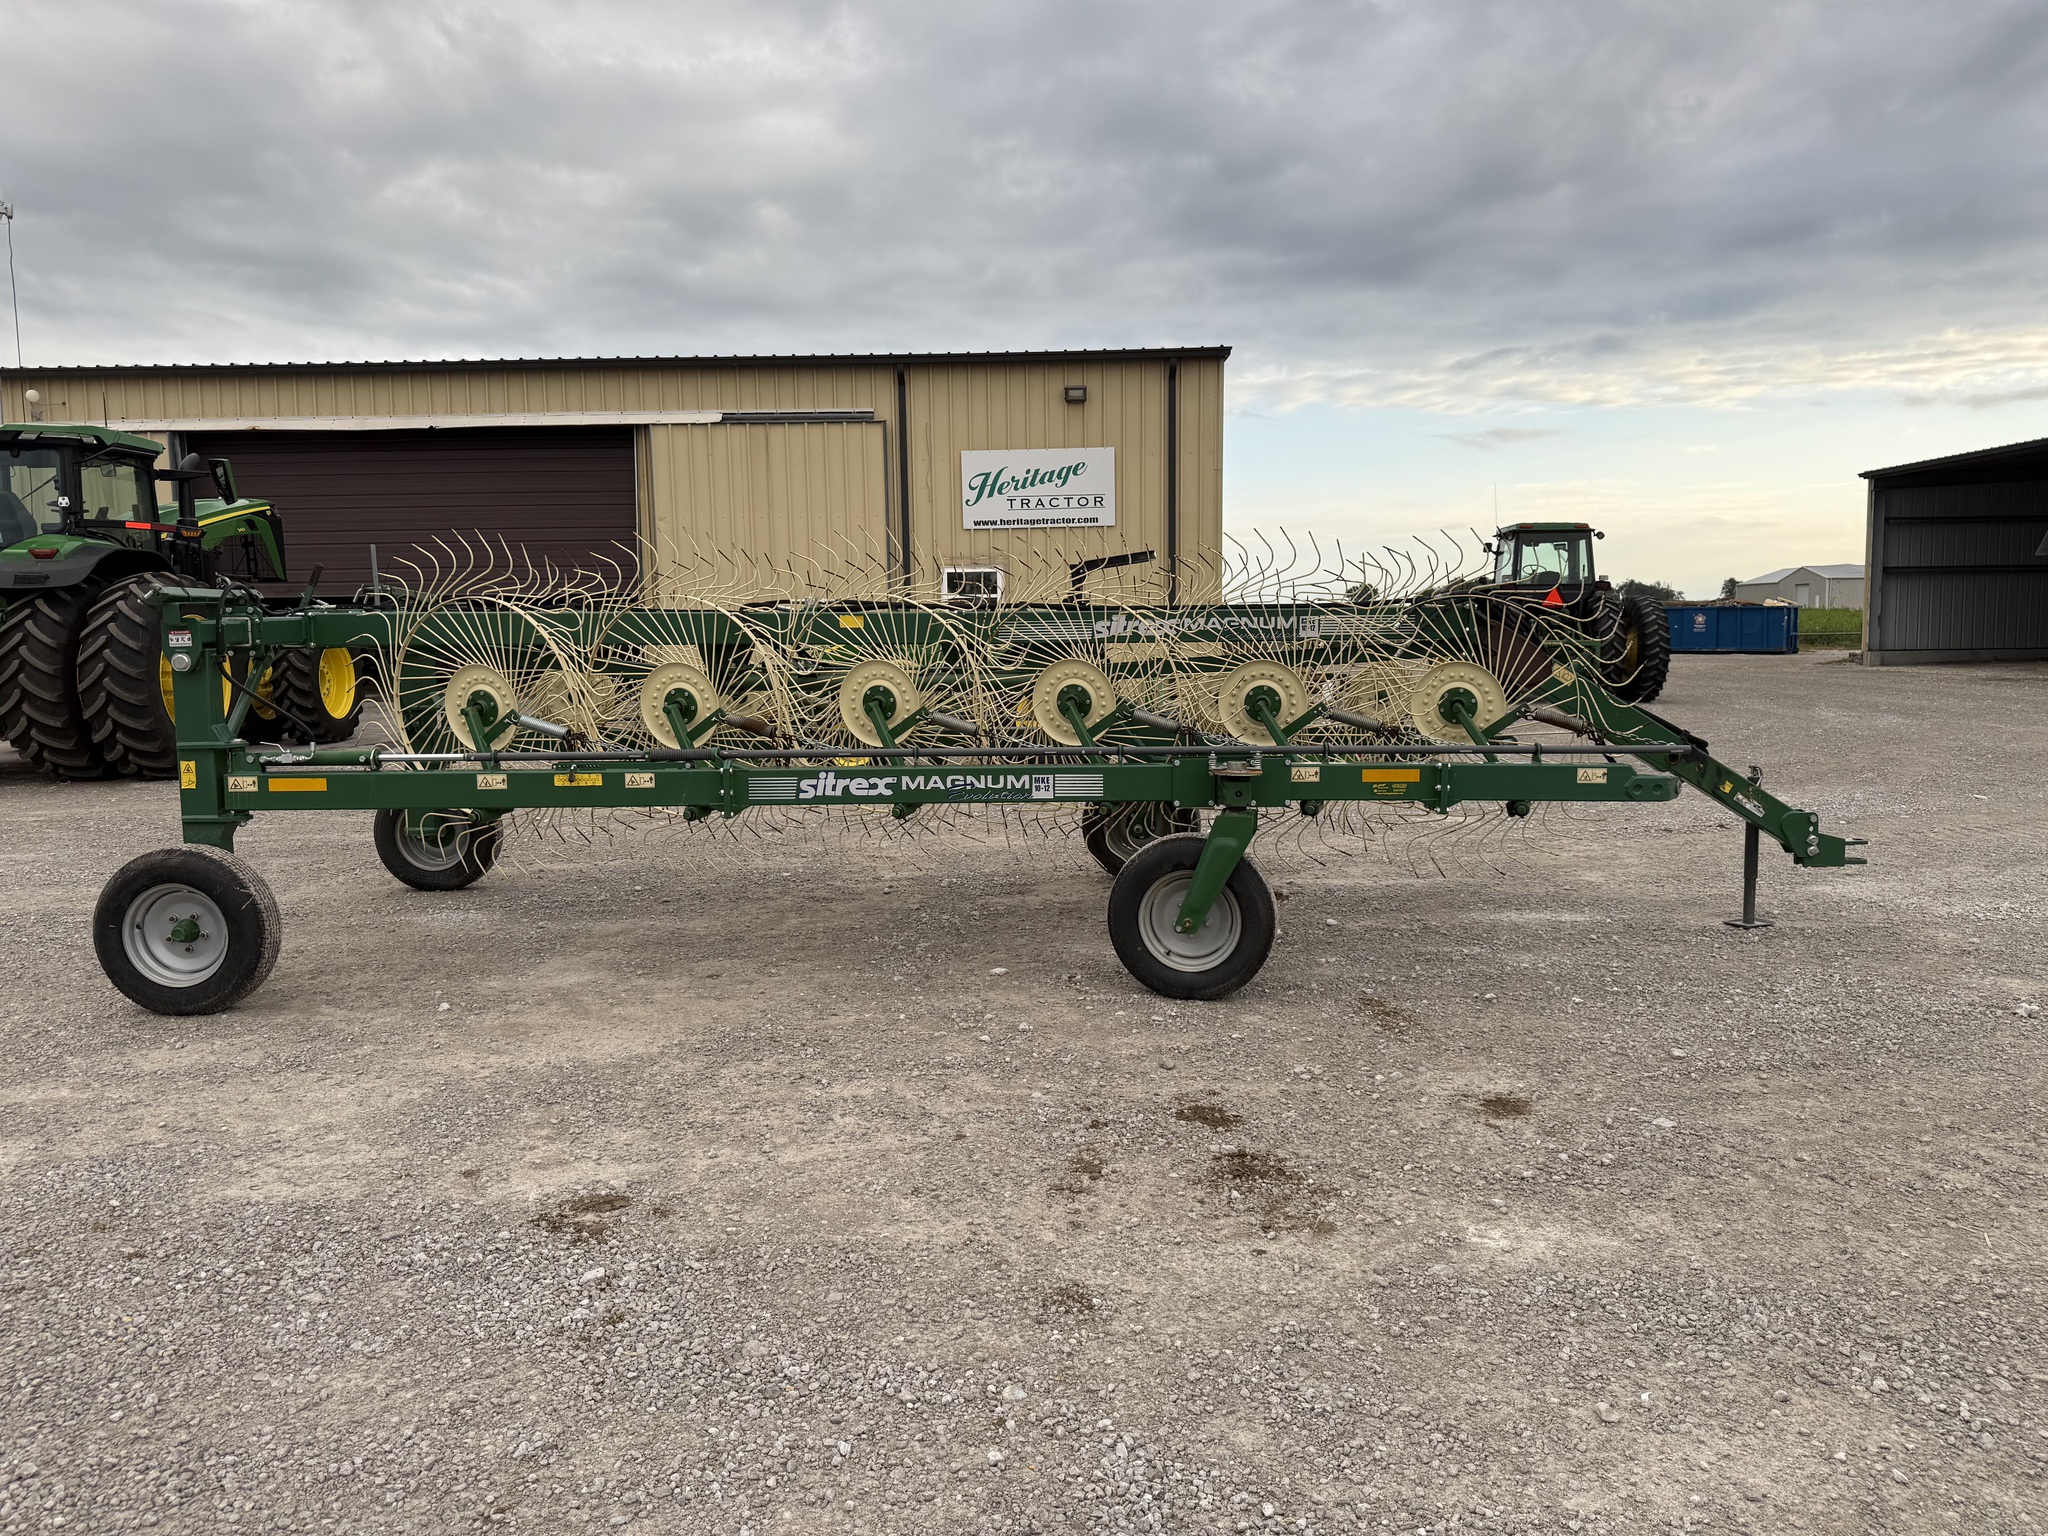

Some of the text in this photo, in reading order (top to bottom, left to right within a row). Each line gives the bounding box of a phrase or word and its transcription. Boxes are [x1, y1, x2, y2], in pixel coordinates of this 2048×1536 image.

[965, 461, 1088, 506] Heritage
[1007, 496, 1104, 509] TRACTOR
[973, 516, 1099, 527] www.heritagetractor.com
[1184, 616, 1297, 631] MAGNUM
[799, 771, 1030, 799] sitrex MAGNUM
[1034, 776, 1050, 785] MKE
[1034, 784, 1050, 792] 10-12
